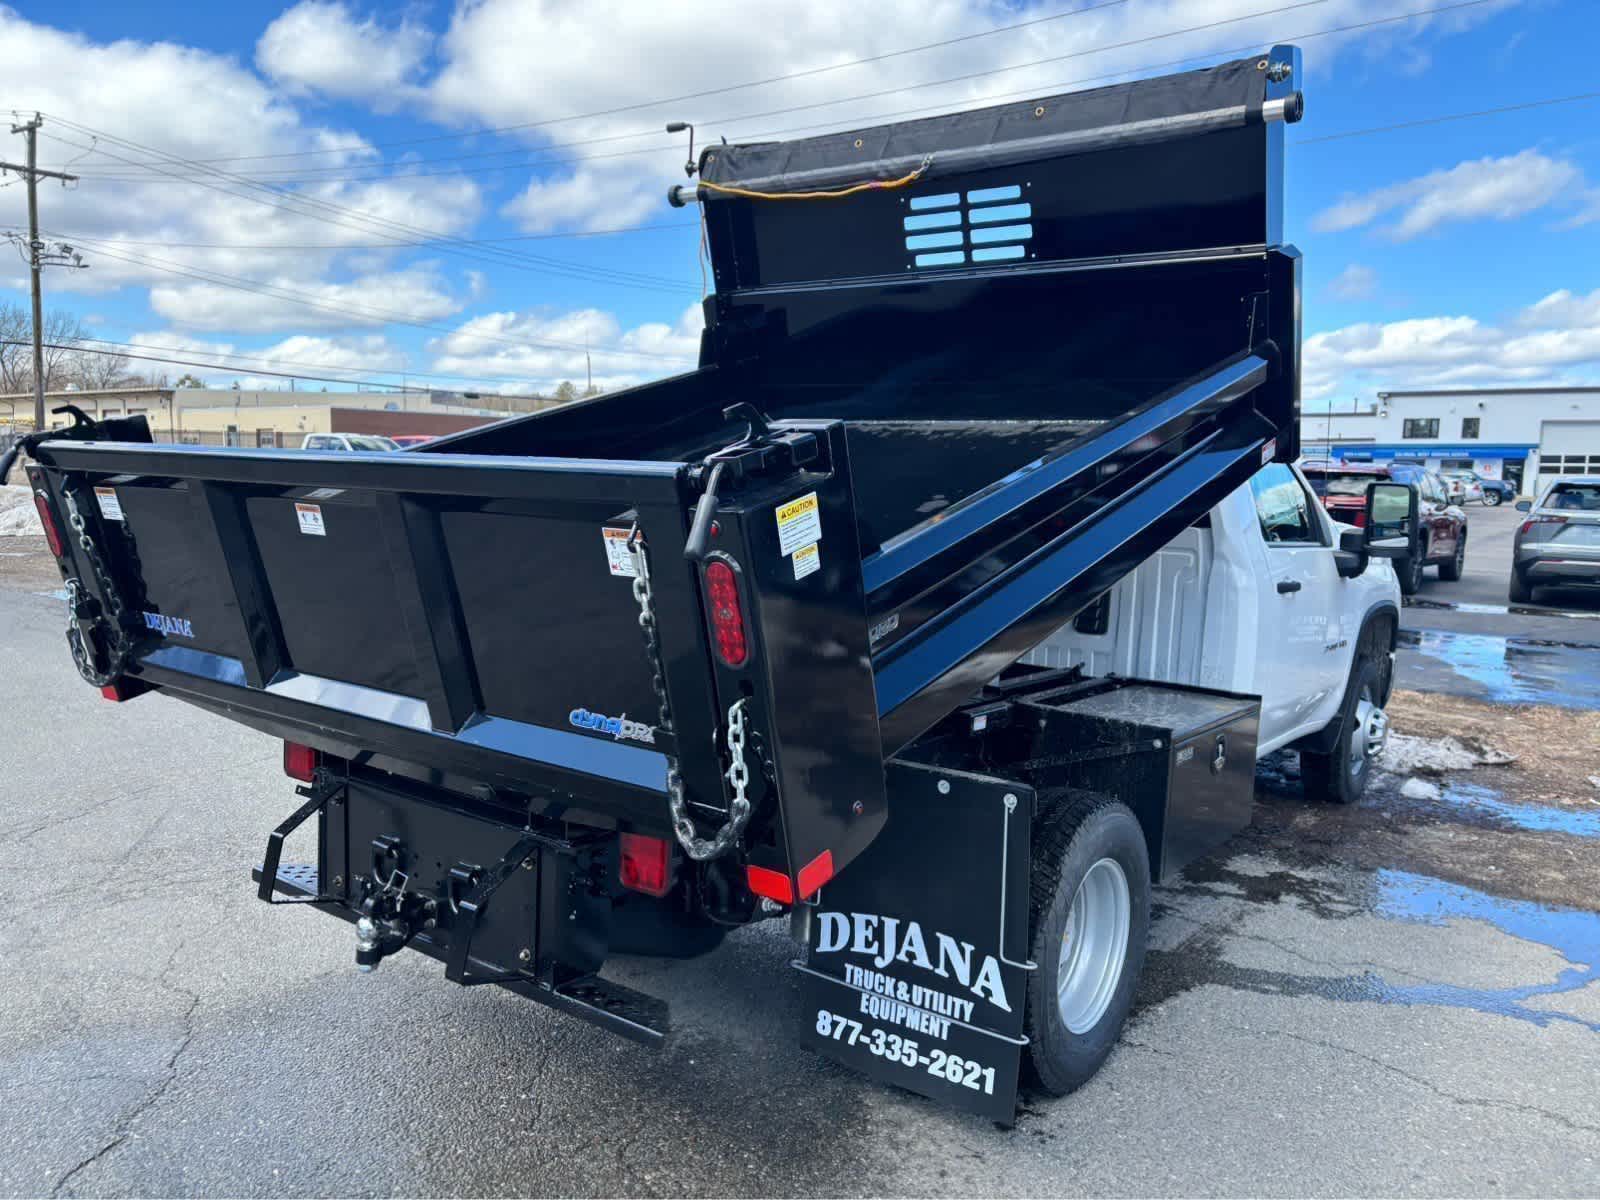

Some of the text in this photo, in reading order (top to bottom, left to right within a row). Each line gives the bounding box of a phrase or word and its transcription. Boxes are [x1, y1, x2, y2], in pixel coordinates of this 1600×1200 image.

[788, 500, 813, 517] CAUTION
[815, 912, 1012, 1012] DEJANA
[844, 964, 976, 1023] TRUCK & UTILITY
[860, 994, 952, 1041] EQUIPMENT
[815, 1010, 995, 1095] 877-335-2621
